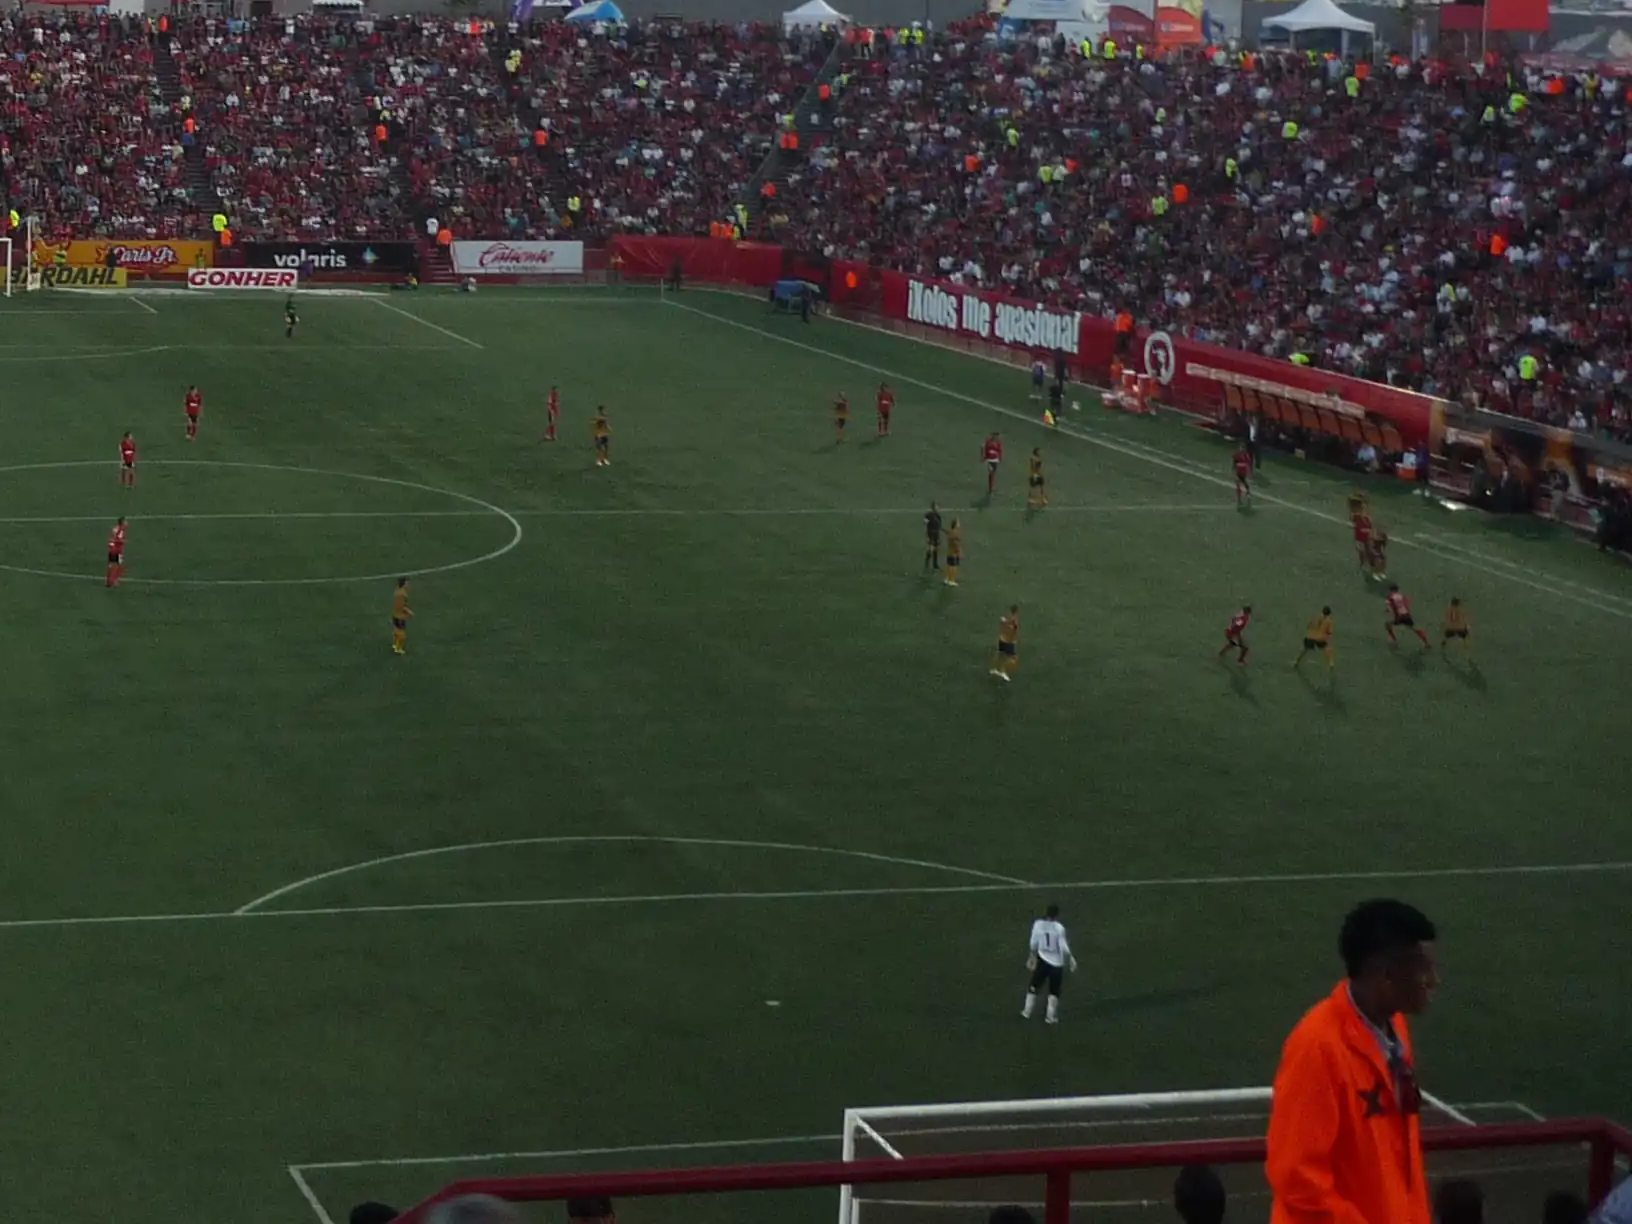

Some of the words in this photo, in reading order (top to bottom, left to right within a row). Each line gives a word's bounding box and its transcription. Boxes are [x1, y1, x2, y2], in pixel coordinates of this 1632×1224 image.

[273, 248, 347, 268] volaris
[188, 271, 295, 286] GONHER
[961, 293, 991, 338] me
[994, 302, 1083, 354] apasiona!
